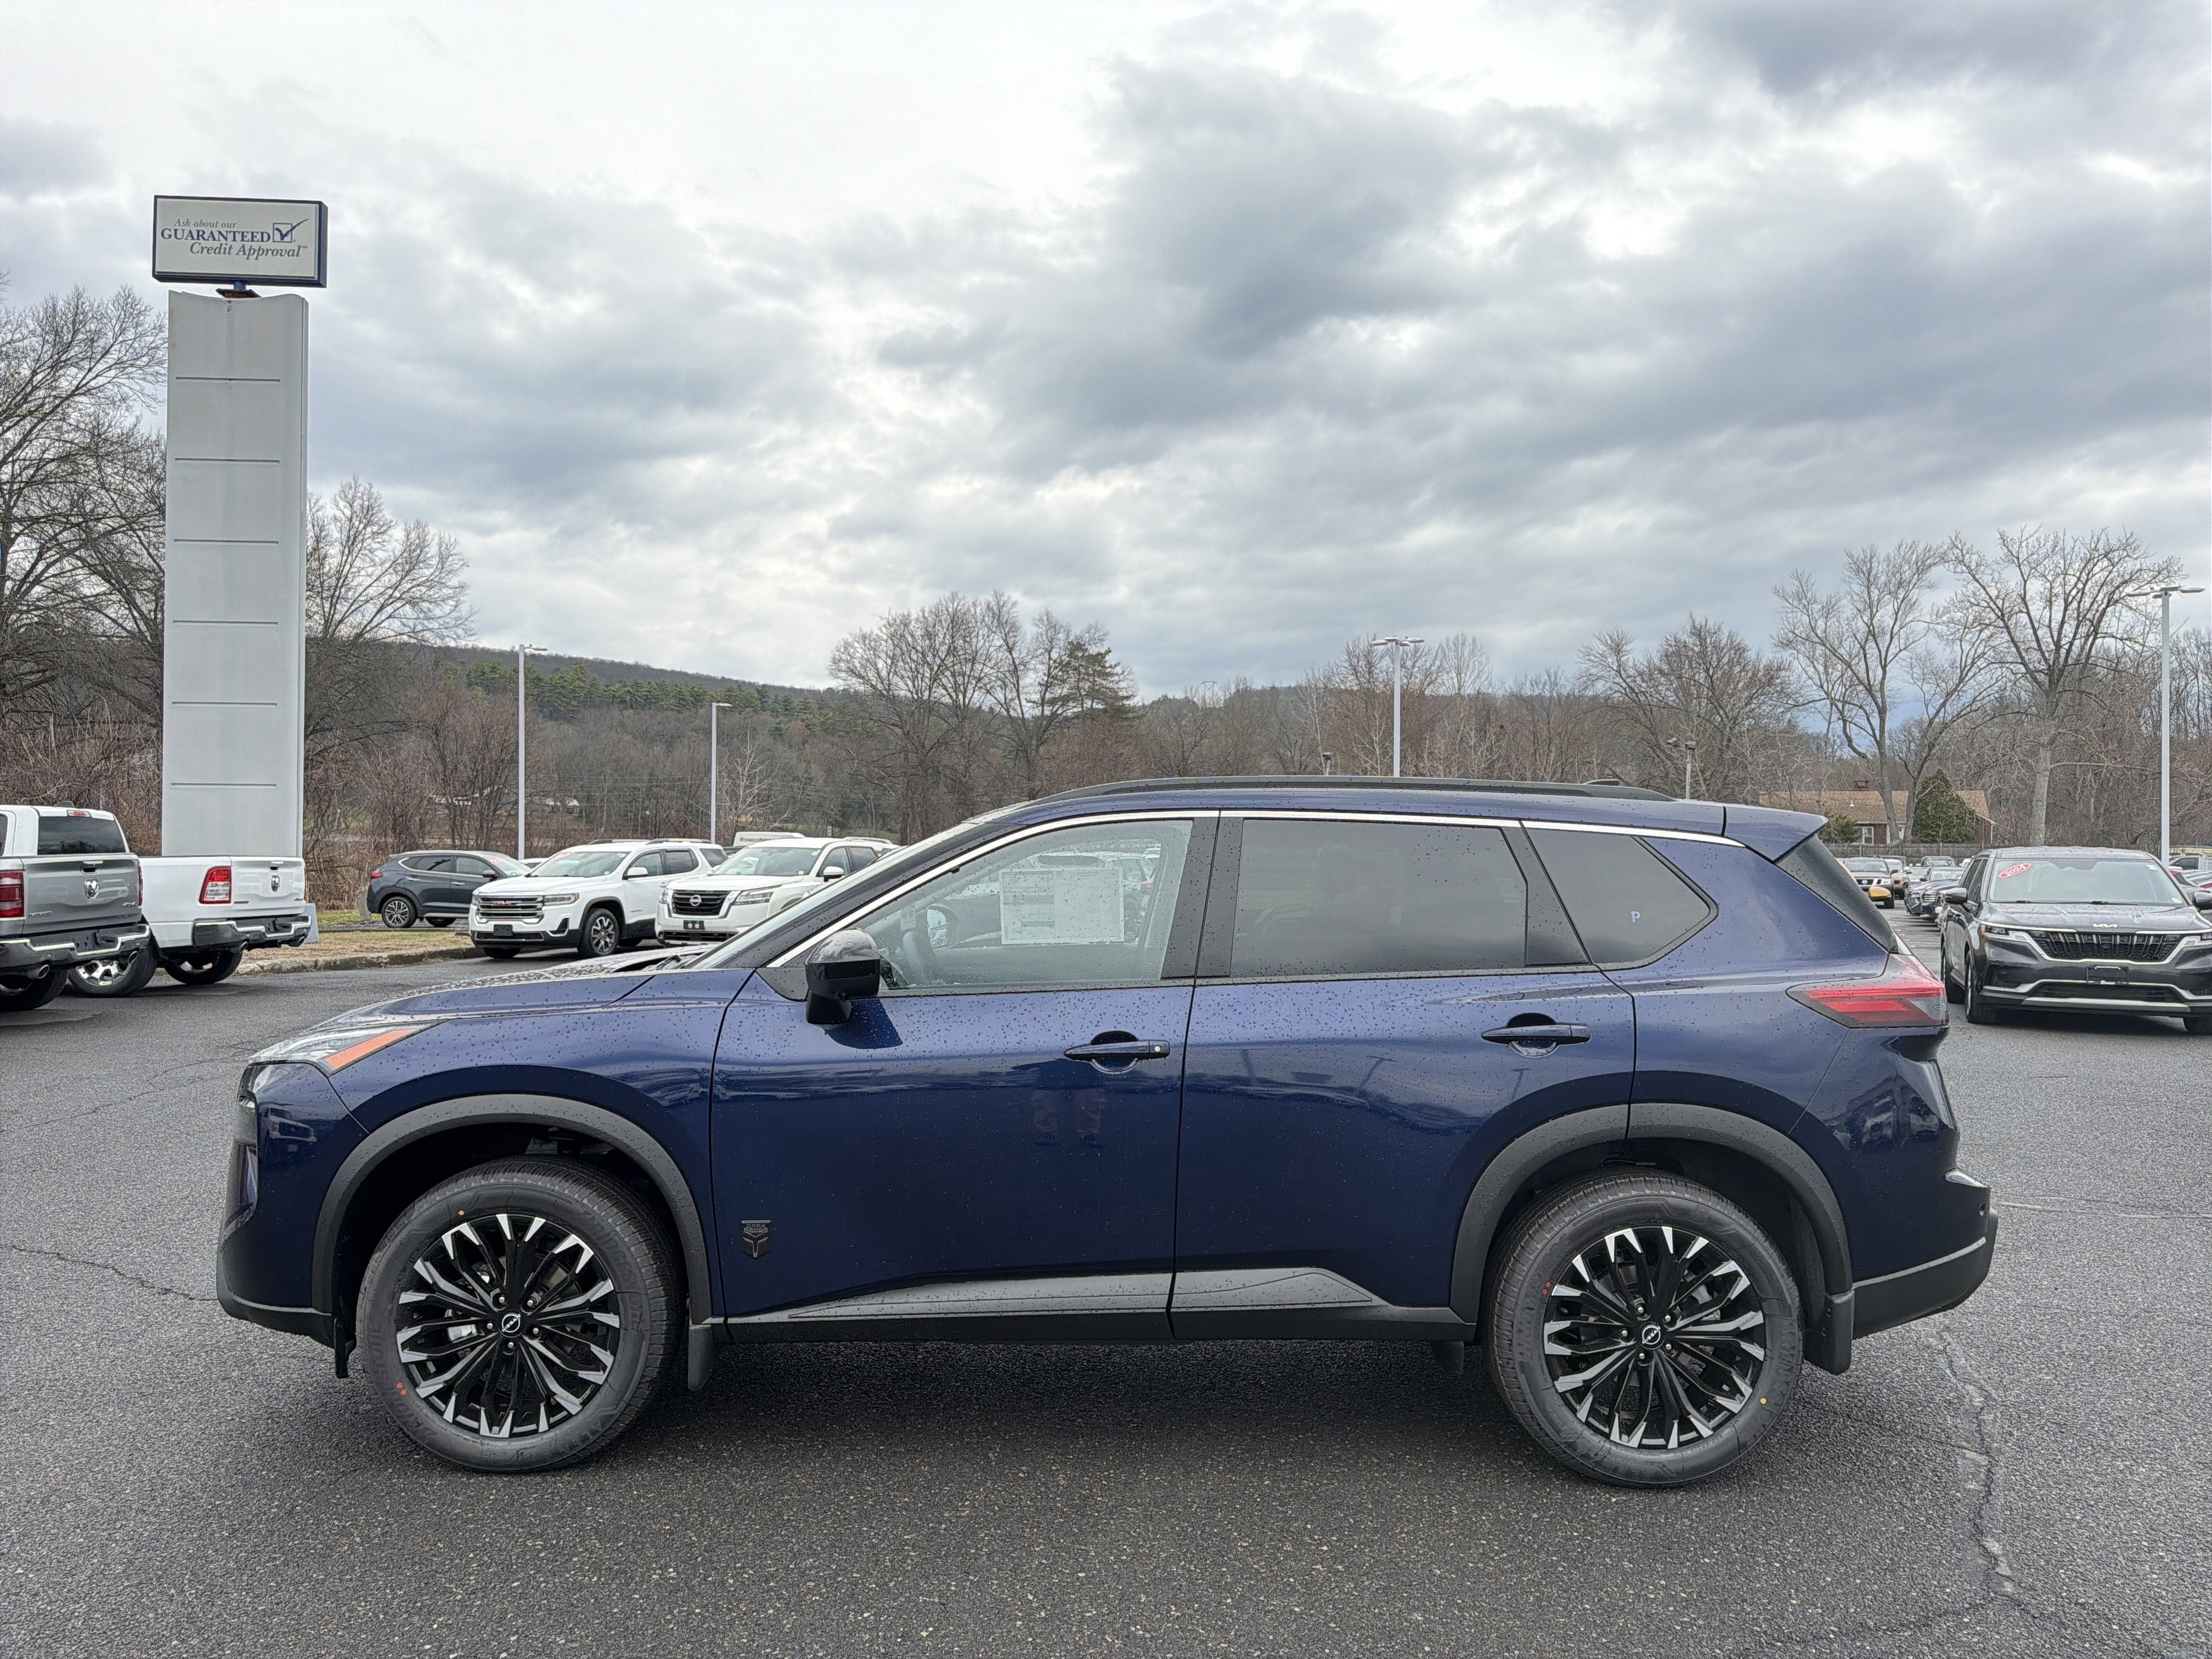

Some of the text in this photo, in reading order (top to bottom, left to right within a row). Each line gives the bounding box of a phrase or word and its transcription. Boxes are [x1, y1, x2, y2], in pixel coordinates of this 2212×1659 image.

[174, 218, 191, 227] Ask
[193, 219, 218, 228] about
[161, 228, 271, 243] GUARANTEED
[190, 242, 233, 256] Credit
[1630, 911, 1641, 923] P
